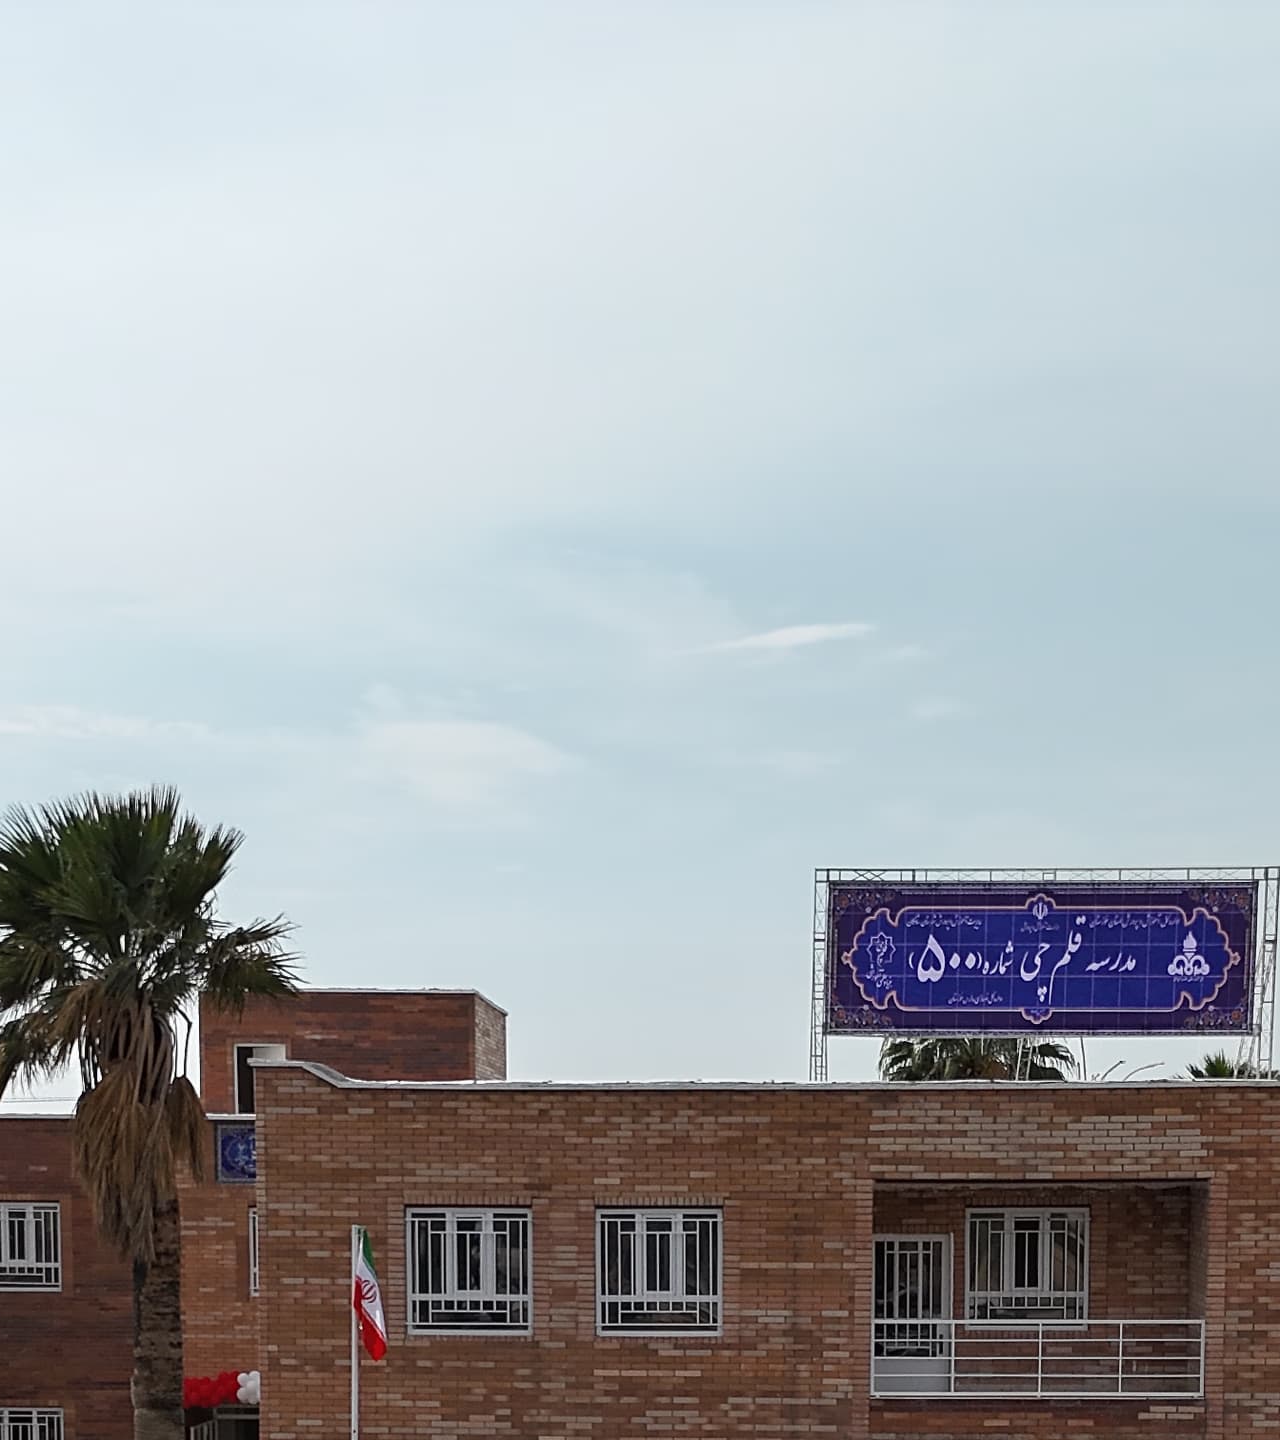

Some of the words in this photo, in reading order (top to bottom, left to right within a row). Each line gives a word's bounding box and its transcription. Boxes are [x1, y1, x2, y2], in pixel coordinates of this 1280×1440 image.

[982, 940, 1014, 975] شماره
[1020, 942, 1050, 1002] چی
[1049, 915, 1086, 1005] قلم
[1085, 952, 1136, 972] مدرسه
